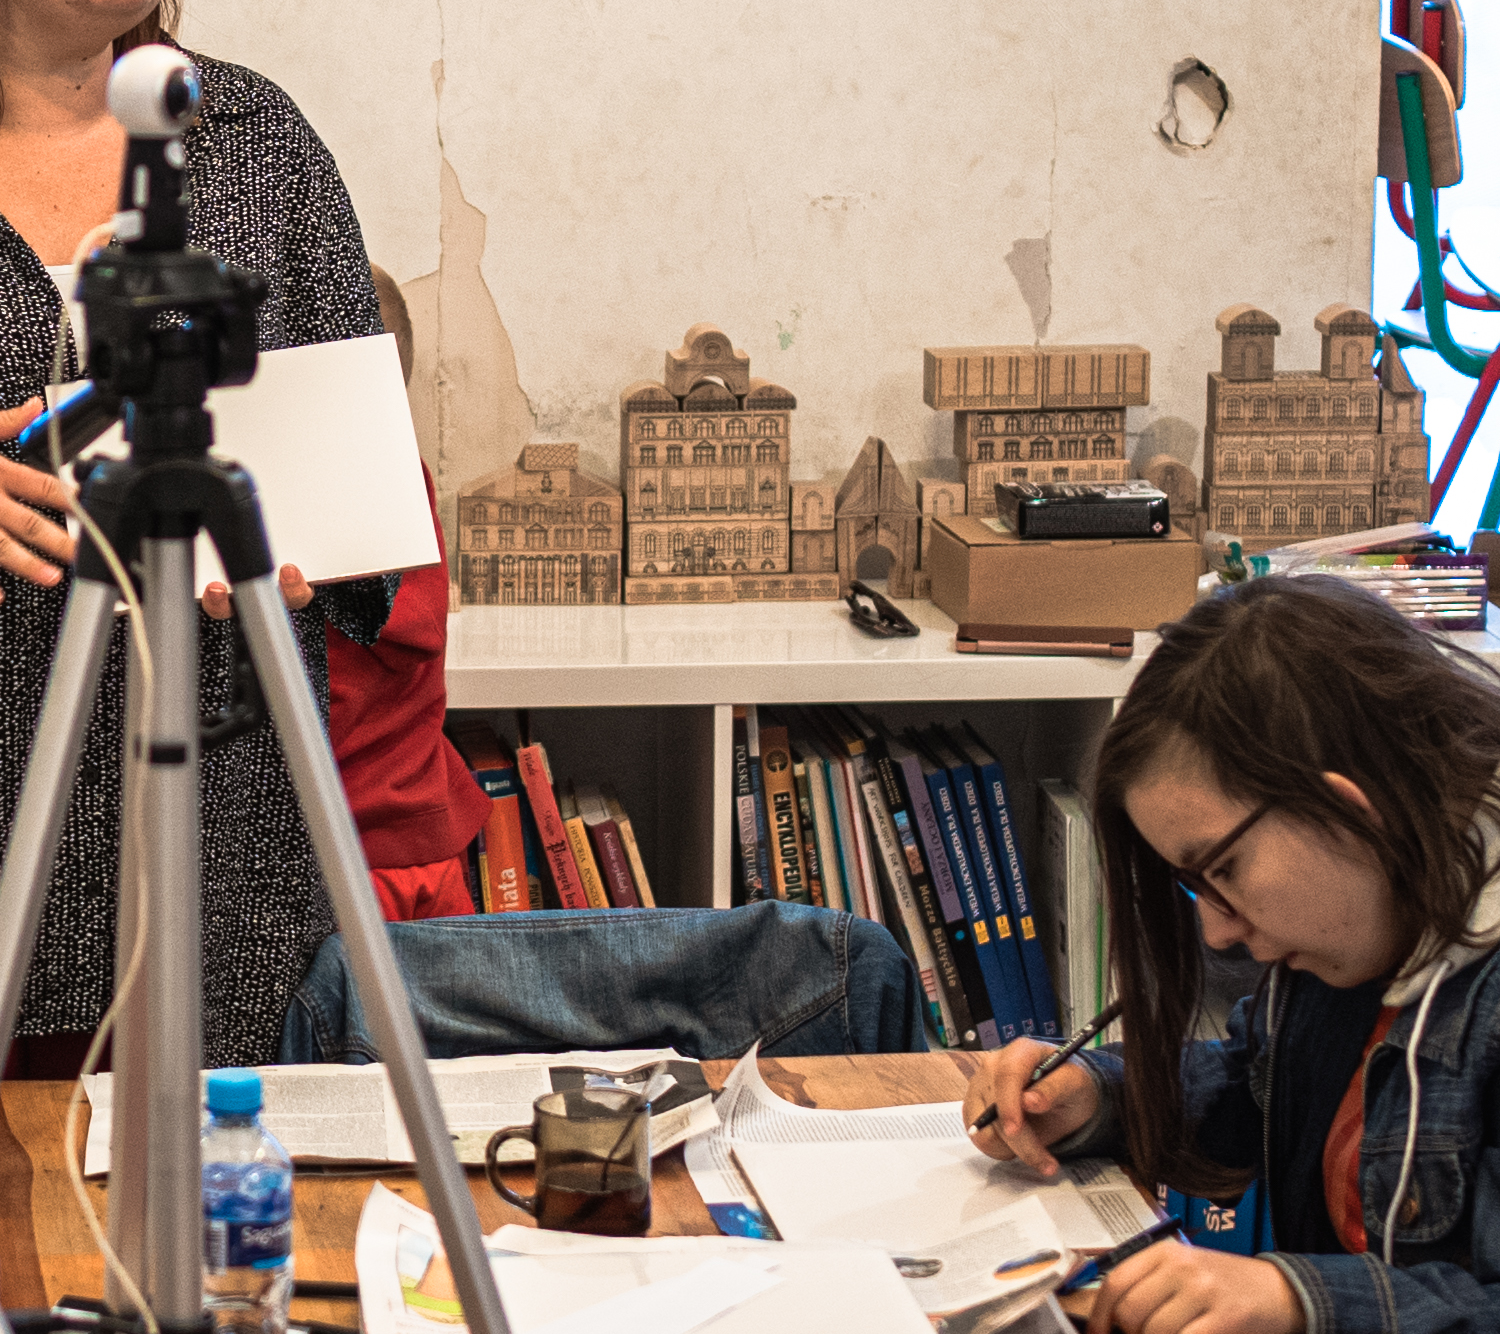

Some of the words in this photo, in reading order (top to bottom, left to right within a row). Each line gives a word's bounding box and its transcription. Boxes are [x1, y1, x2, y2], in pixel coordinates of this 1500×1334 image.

[735, 744, 750, 794] POLSKIE
[570, 825, 587, 863] HISTORIA
[773, 791, 802, 901] ENCYKLOPEDIA
[499, 867, 520, 912] iata
[919, 884, 936, 924] Morze
